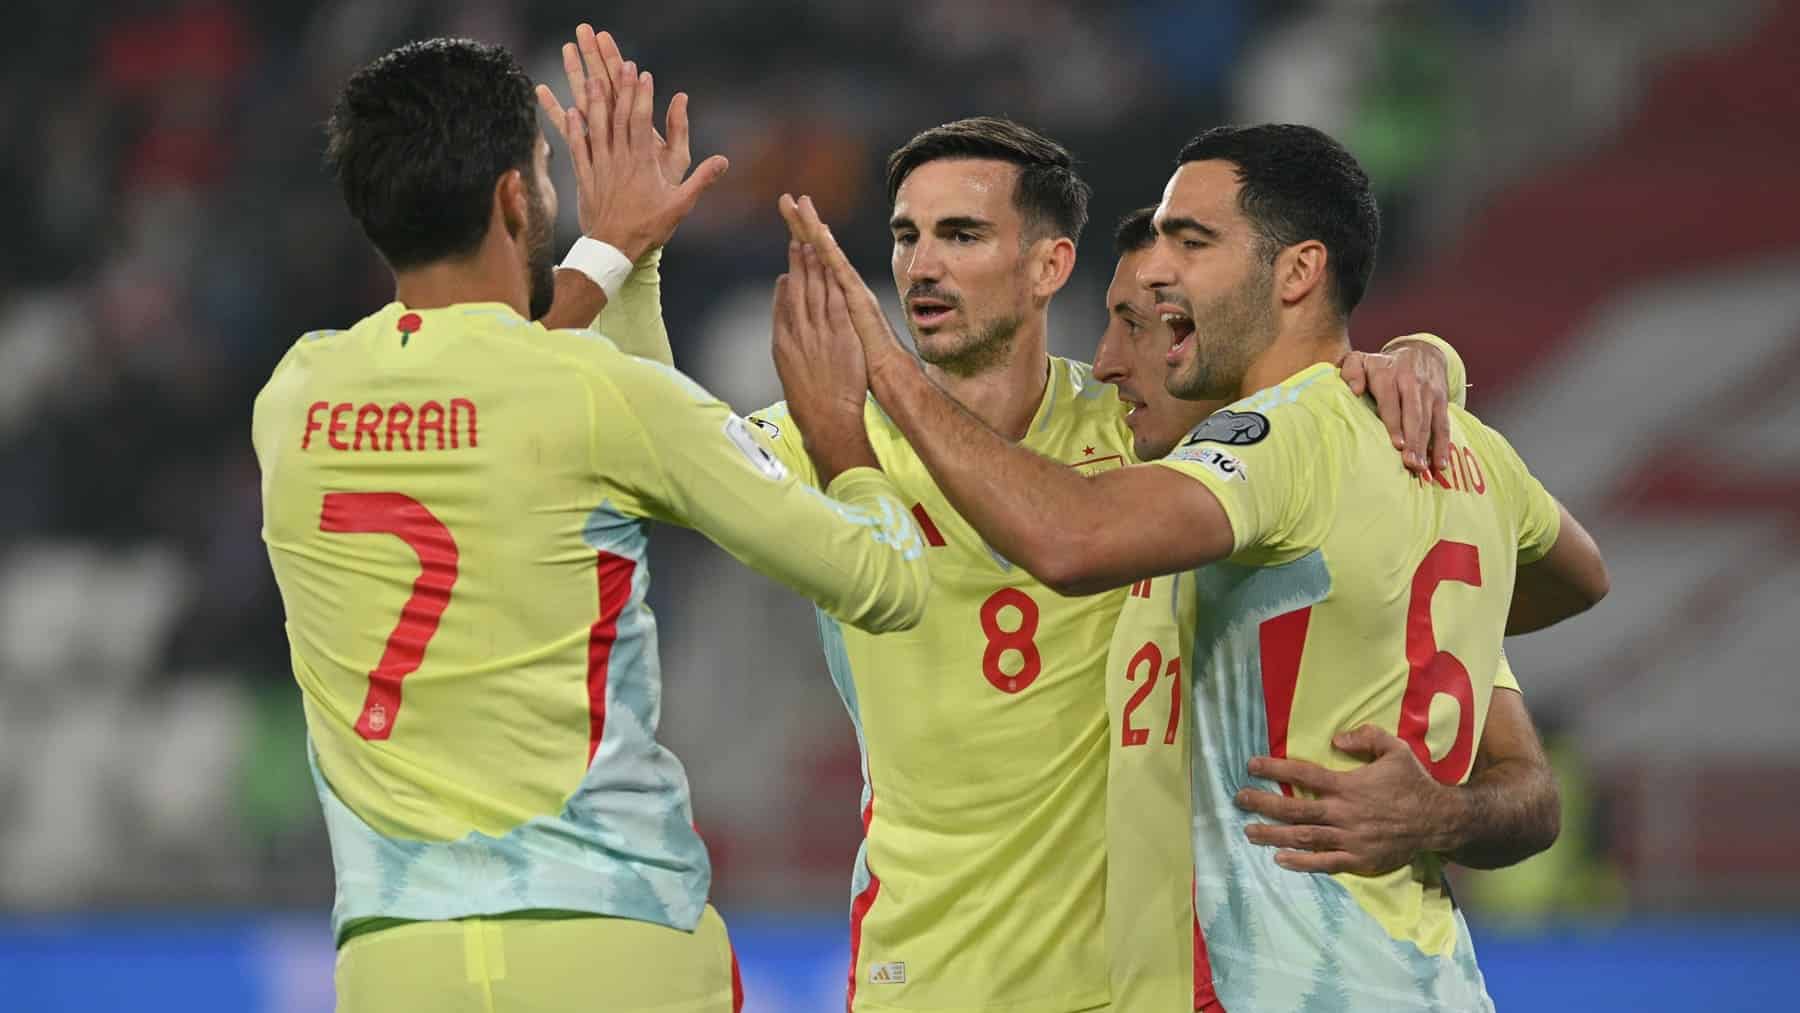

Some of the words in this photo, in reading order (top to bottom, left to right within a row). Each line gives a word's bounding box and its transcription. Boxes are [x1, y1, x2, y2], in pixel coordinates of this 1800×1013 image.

[301, 398, 477, 451] FERRAN
[319, 491, 459, 741] 7
[979, 587, 1042, 694] 8
[1397, 539, 1482, 785] 6
[1122, 641, 1181, 747] 21
